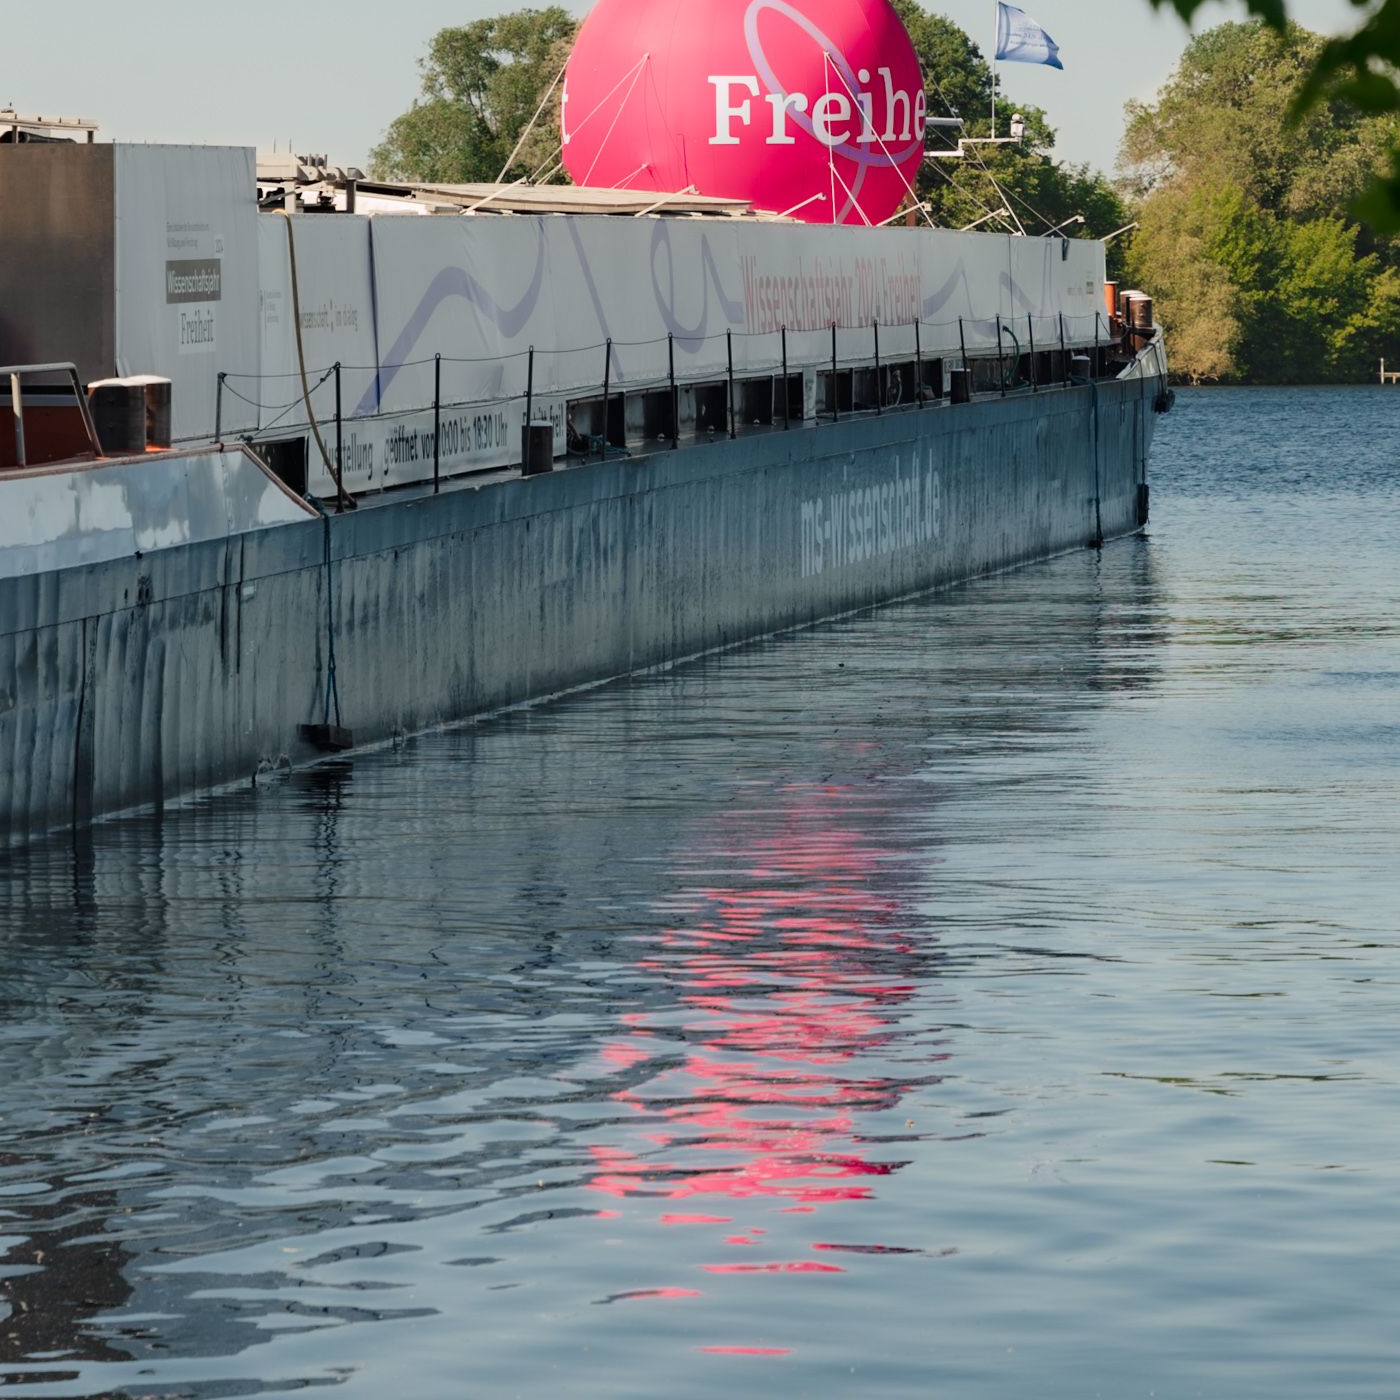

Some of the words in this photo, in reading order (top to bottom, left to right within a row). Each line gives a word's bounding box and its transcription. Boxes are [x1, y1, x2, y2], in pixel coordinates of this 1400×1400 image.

[167, 268, 220, 294] Wissenschaftsjahr
[180, 309, 214, 345] Freiheit
[384, 425, 418, 476] geöffnet
[460, 415, 471, 453] bis
[473, 413, 493, 450] 18:30
[495, 411, 508, 448] Uhr
[801, 448, 940, 578] ms-wissenschaft.de
